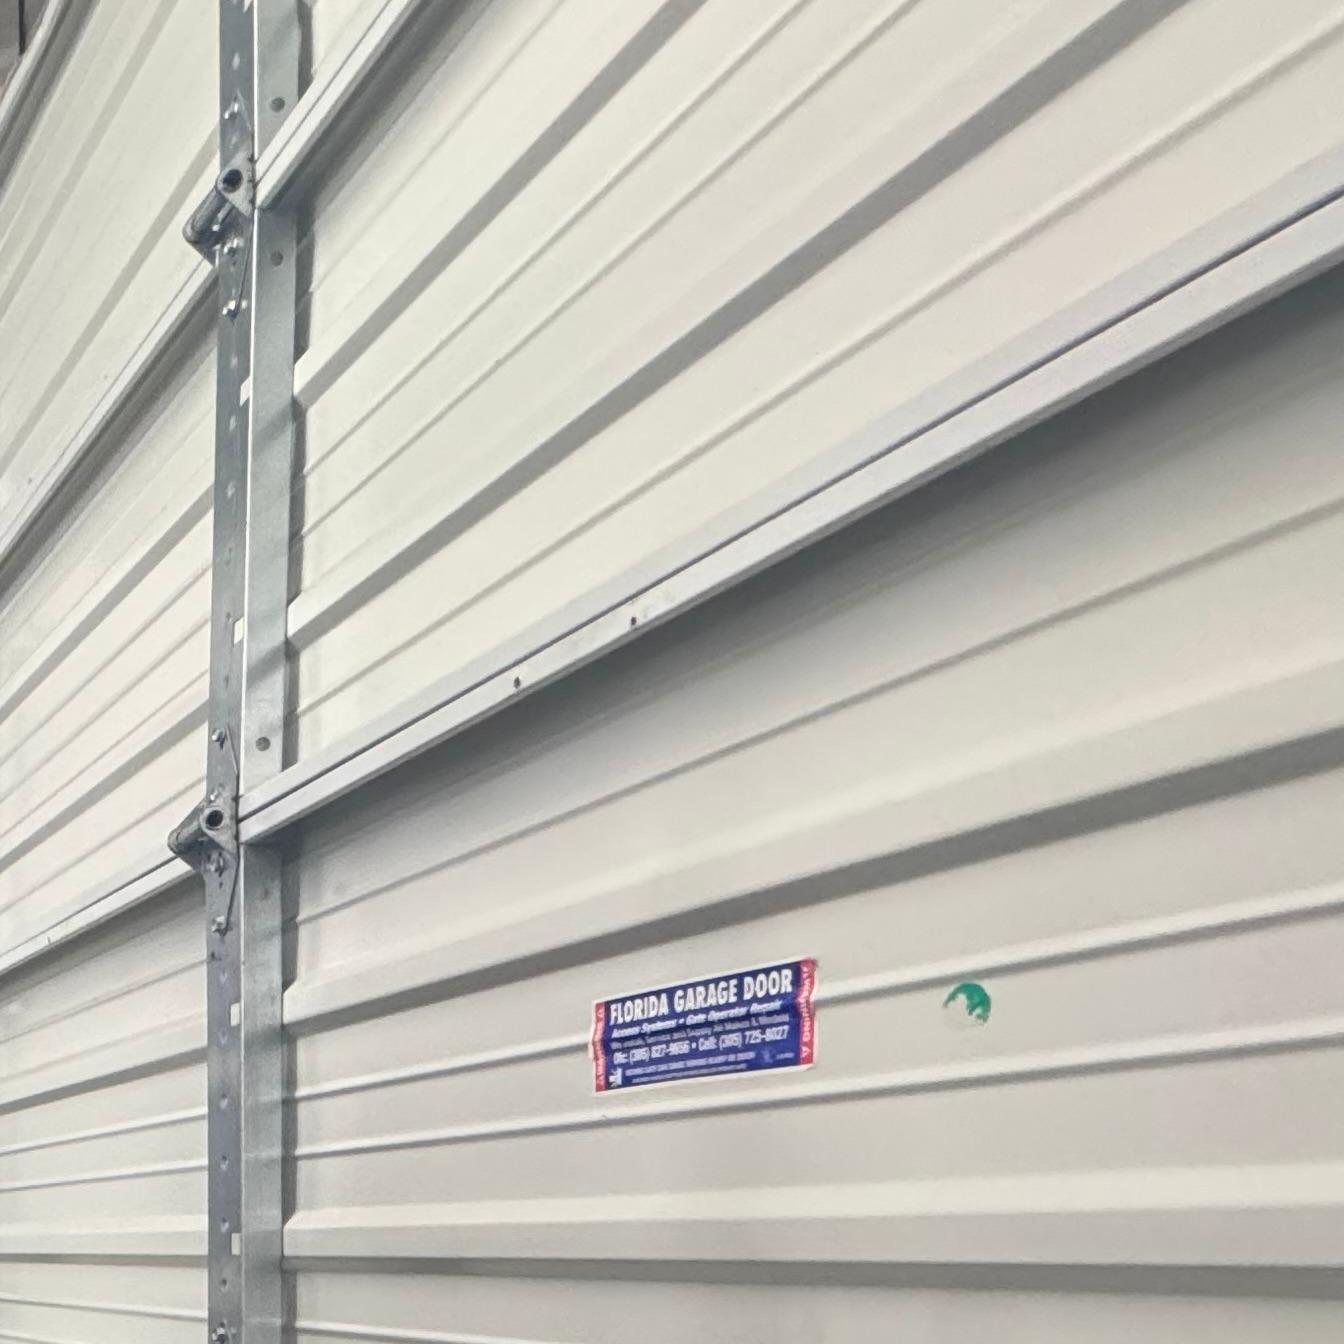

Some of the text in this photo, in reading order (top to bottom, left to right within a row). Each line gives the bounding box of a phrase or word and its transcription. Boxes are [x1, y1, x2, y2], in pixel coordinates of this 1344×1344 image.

[609, 968, 793, 1026] FLORIDA GARAGE DOOR
